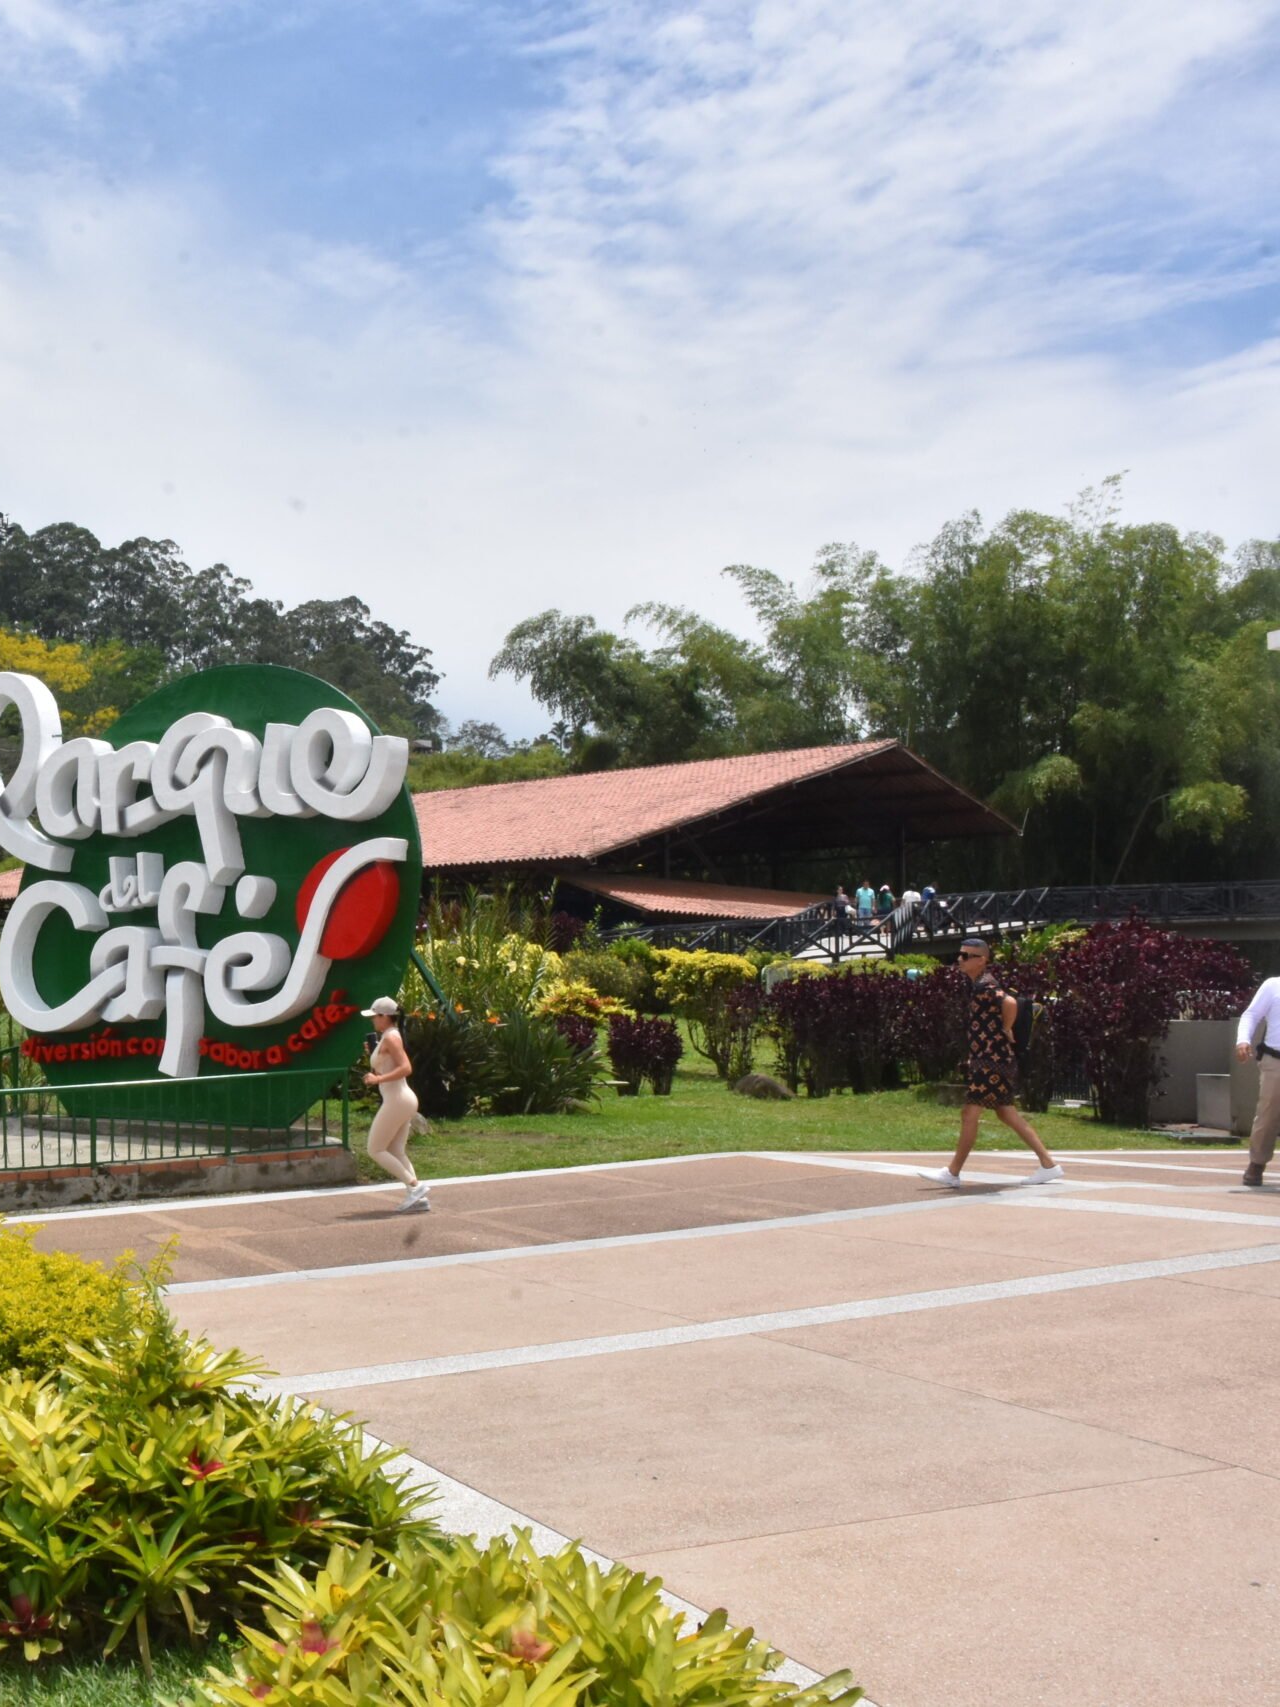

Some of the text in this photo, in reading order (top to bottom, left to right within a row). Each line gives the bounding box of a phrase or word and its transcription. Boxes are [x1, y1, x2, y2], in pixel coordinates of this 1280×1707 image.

[99, 851, 163, 912] del
[22, 1027, 124, 1063] diversión
[198, 1036, 261, 1070] sabor
[267, 1045, 285, 1065] a
